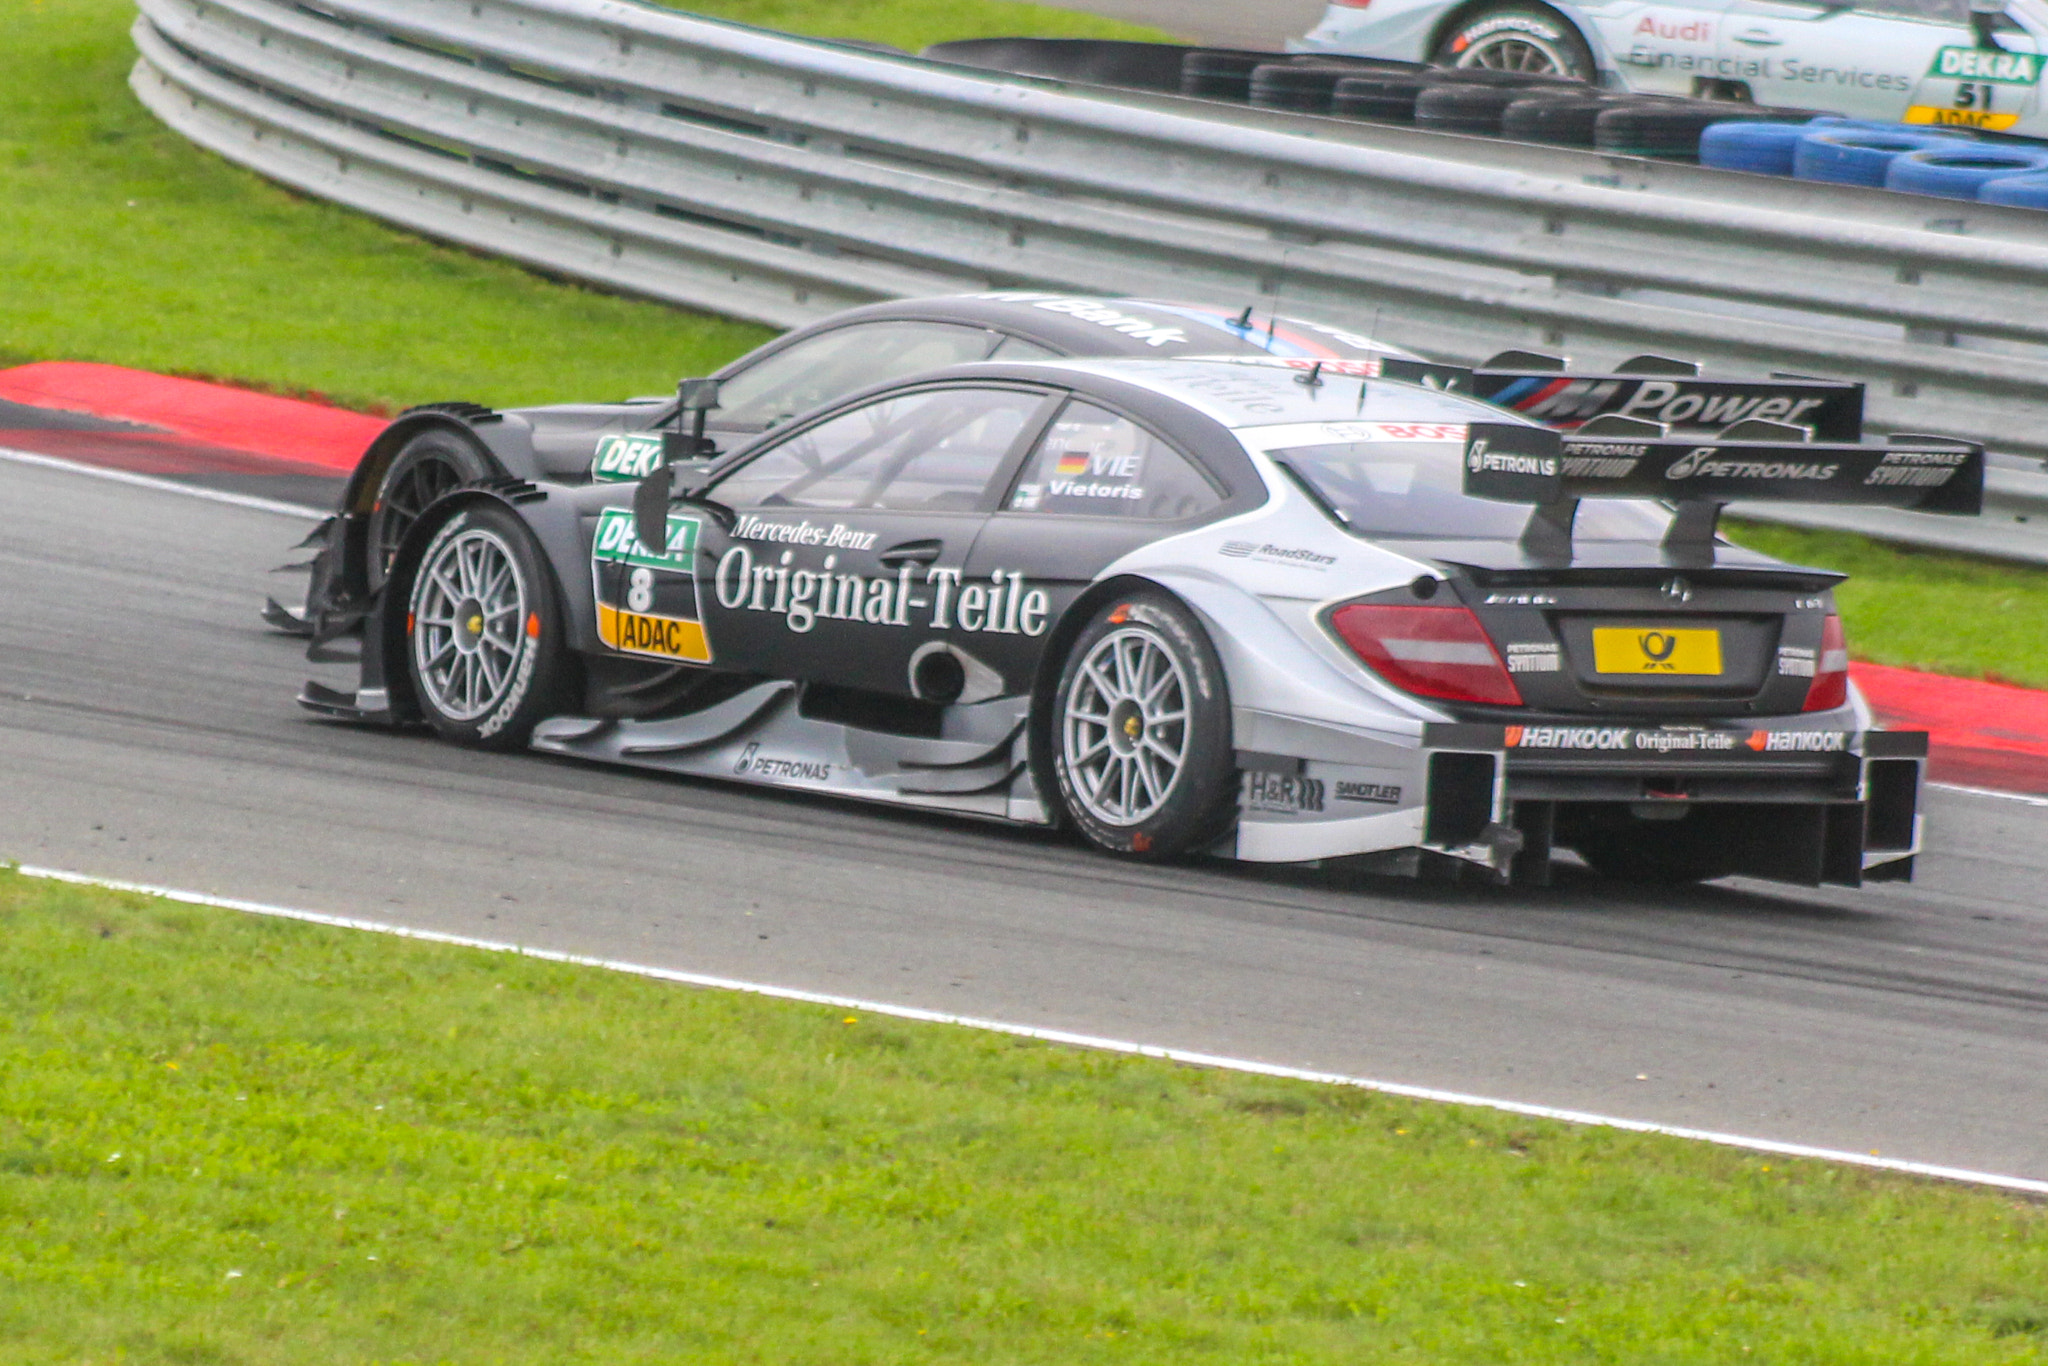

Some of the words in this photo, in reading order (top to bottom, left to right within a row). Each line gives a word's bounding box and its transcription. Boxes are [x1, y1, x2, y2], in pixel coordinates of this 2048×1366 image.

[1633, 17, 1709, 42] Audi
[1630, 44, 1770, 78] Financial
[1782, 58, 1911, 91] Services
[1940, 49, 2032, 81] DEKRA
[1953, 82, 1993, 110] 51
[1618, 381, 1824, 424] Power
[1378, 424, 1468, 441] BOS
[600, 439, 664, 477] DEK
[1563, 443, 1648, 457] PETRONAS
[1880, 452, 1968, 466] PETRONAS
[1091, 455, 1141, 478] VIE
[1484, 454, 1556, 476] PETRONAS
[1696, 461, 1840, 481] PETRONAS
[1049, 480, 1144, 500] Vietoris
[730, 513, 878, 552] Mercedes-Benz
[1259, 543, 1337, 565] RoadStars
[628, 567, 655, 613] 8
[715, 546, 1049, 637] Original-Teile
[622, 616, 682, 655] ADAC
[1635, 732, 1734, 753] Original-Teile
[752, 758, 832, 781] PETRONAS
[1249, 772, 1295, 803] H&R
